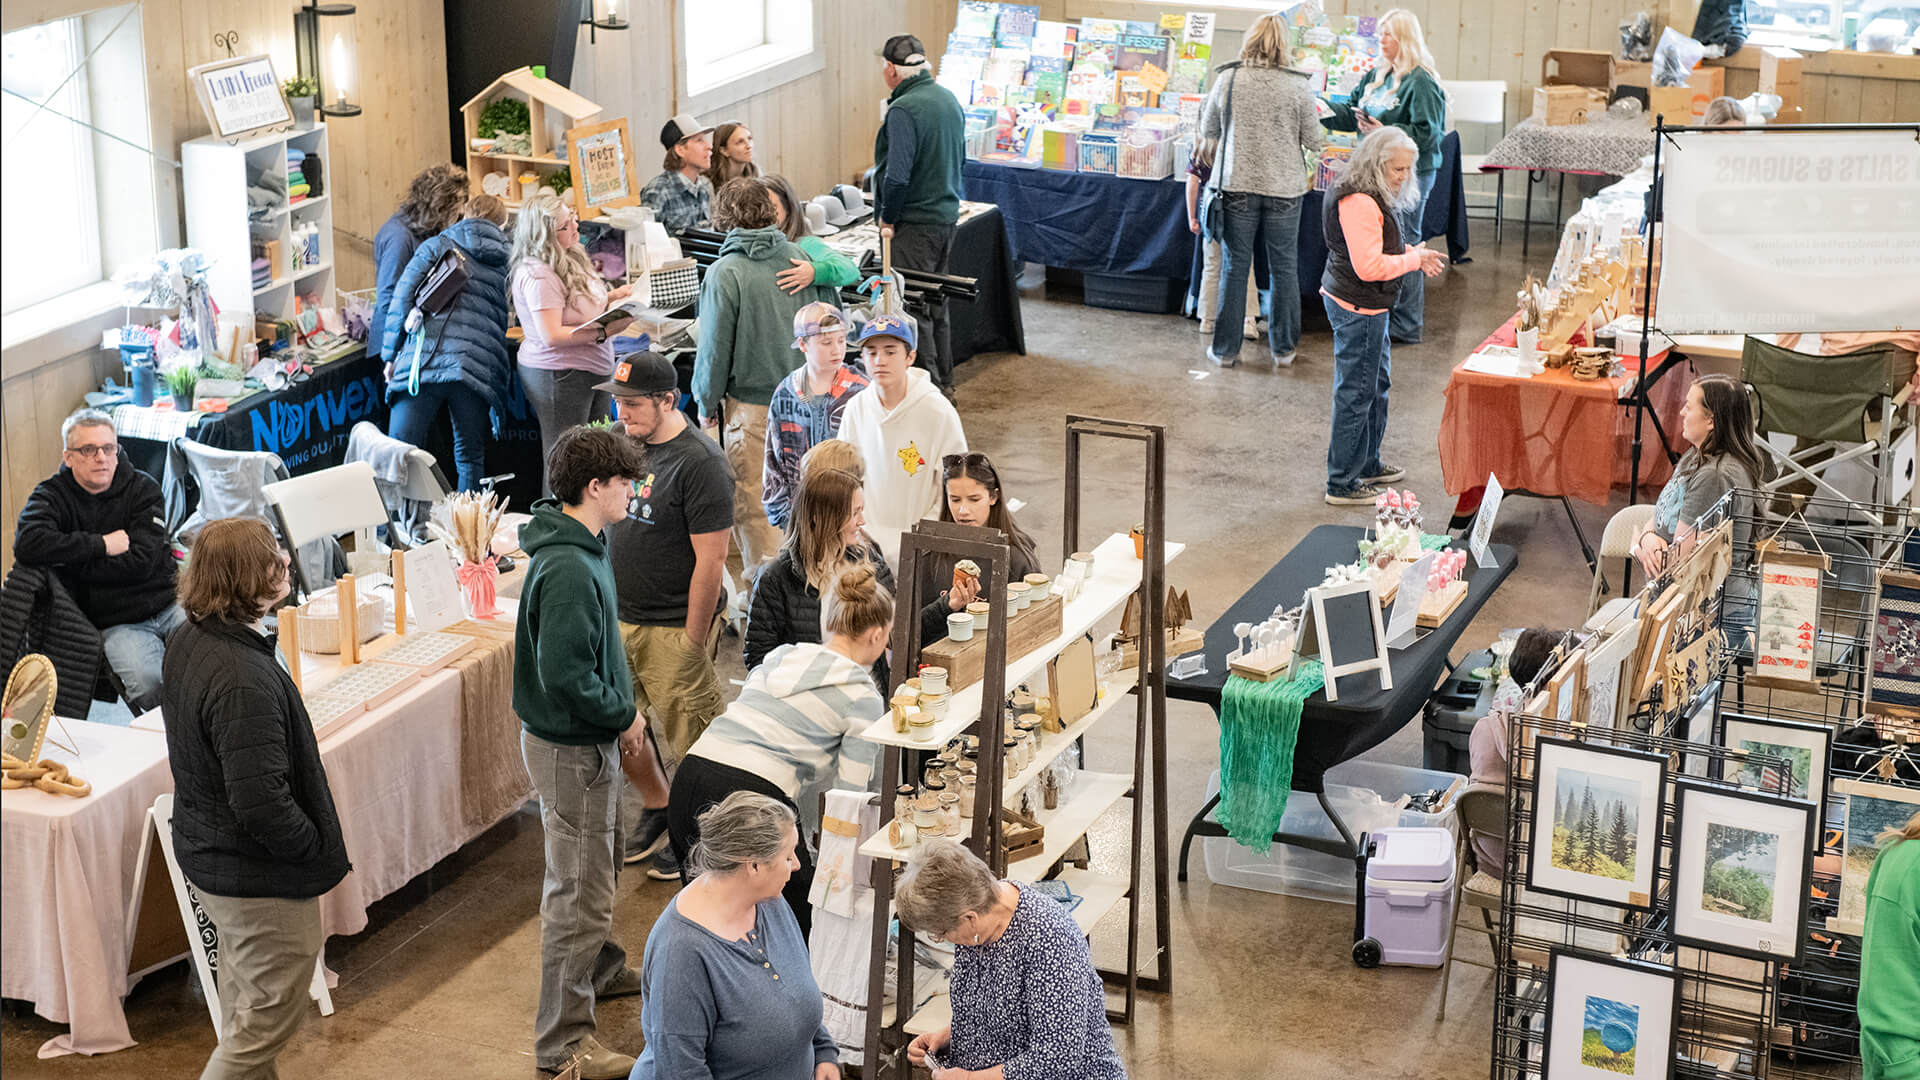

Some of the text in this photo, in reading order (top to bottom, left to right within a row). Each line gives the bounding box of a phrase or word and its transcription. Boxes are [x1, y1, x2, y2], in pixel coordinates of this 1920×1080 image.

[1118, 34, 1167, 50] LIFESIZE
[589, 147, 615, 163] HOST
[249, 376, 379, 452] Norwex
